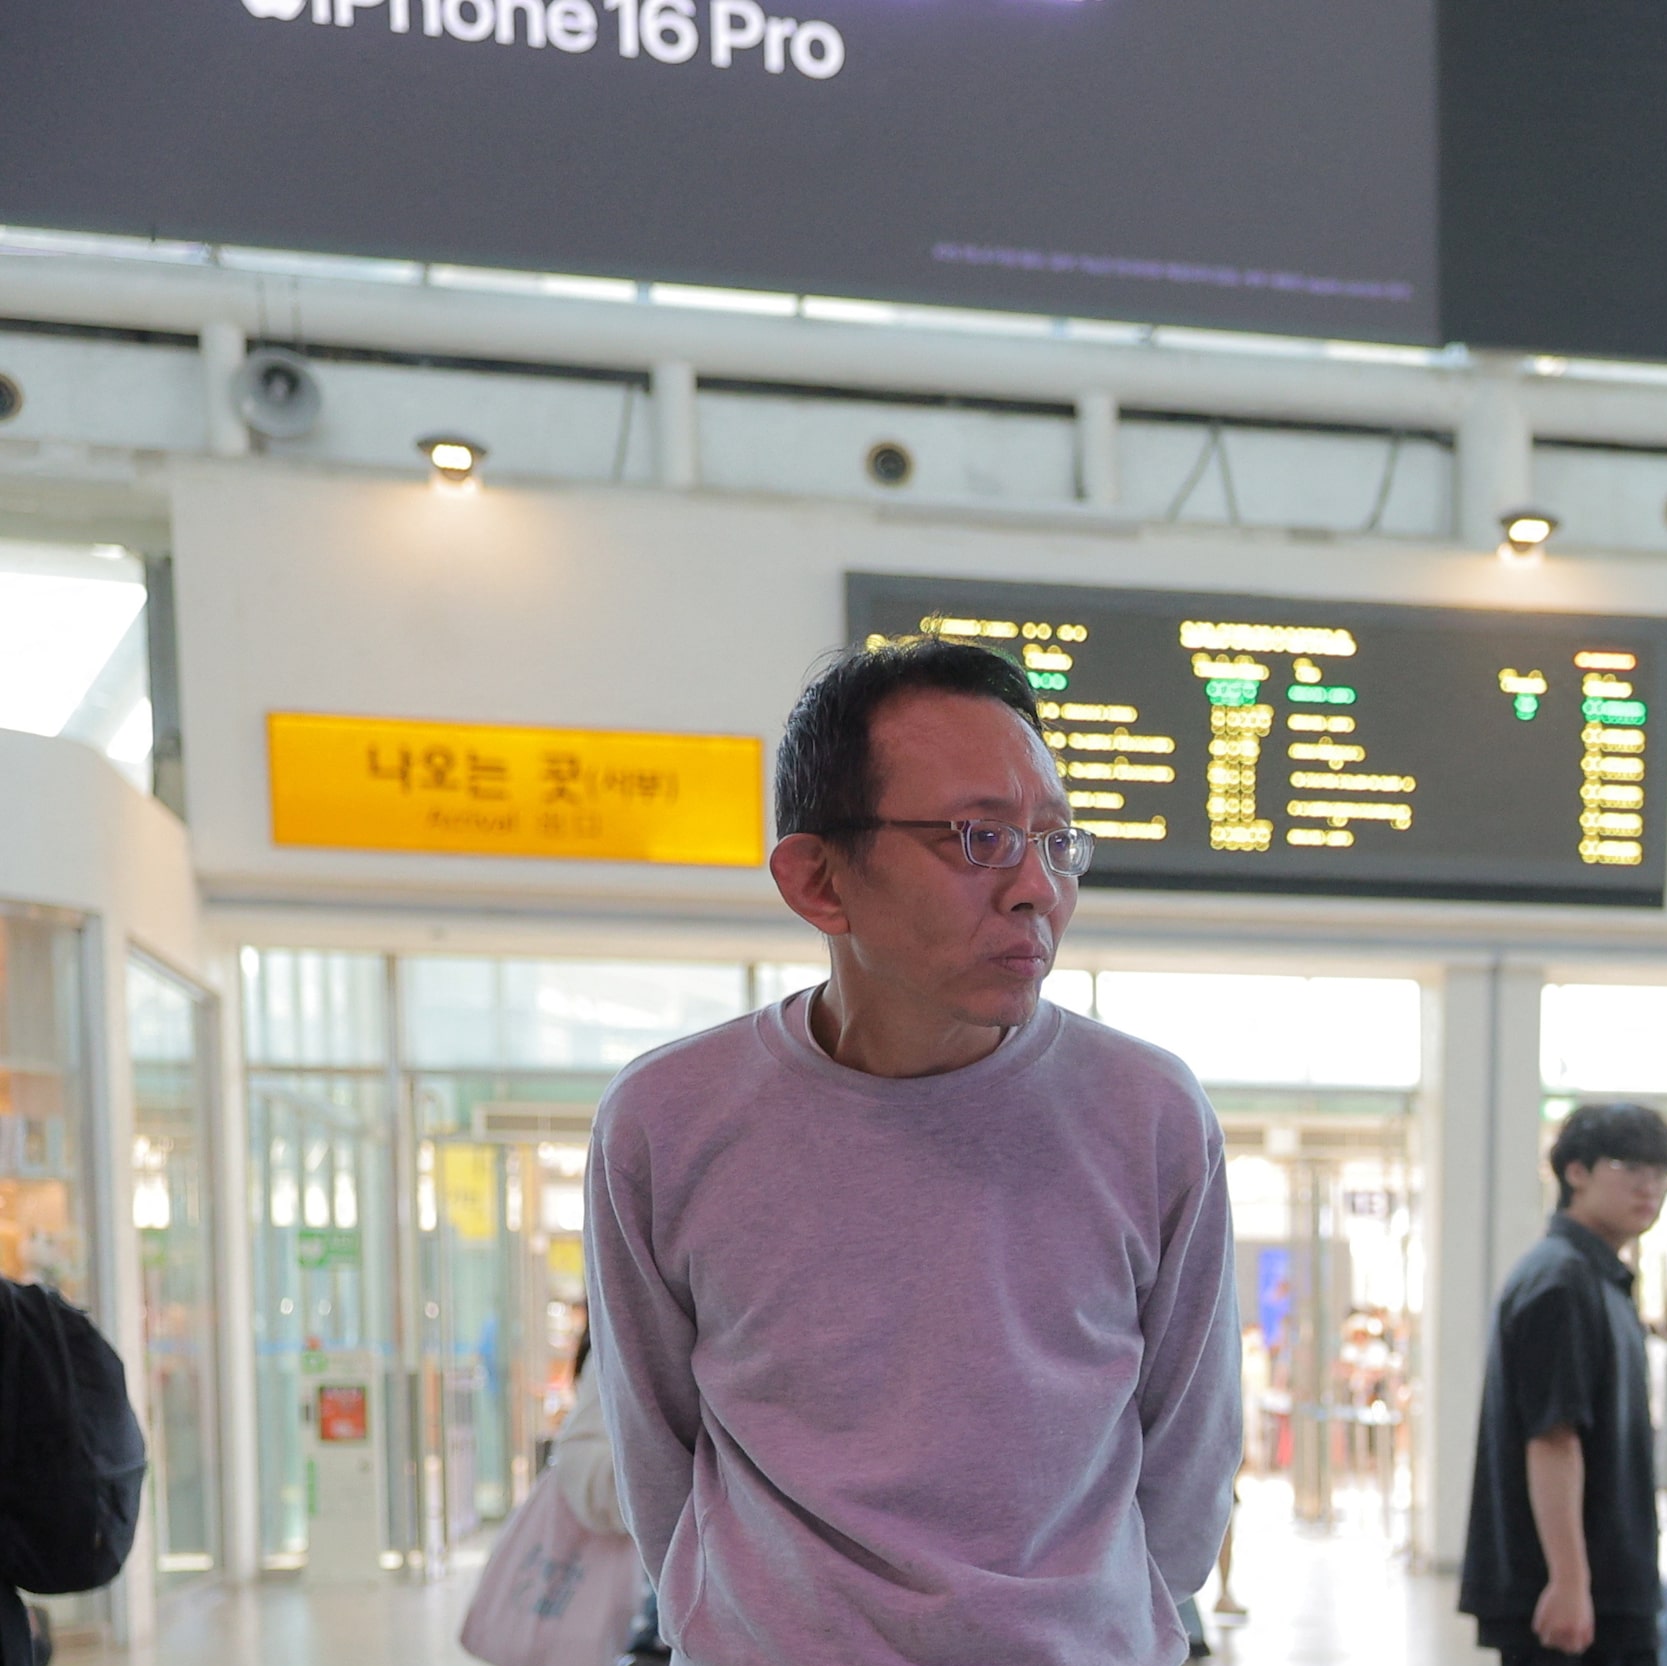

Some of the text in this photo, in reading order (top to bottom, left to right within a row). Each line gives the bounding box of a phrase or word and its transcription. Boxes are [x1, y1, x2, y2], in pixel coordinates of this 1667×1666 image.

[604, 0, 699, 64] 16
[710, 0, 846, 79] Pro
[367, 740, 508, 801] 나오는
